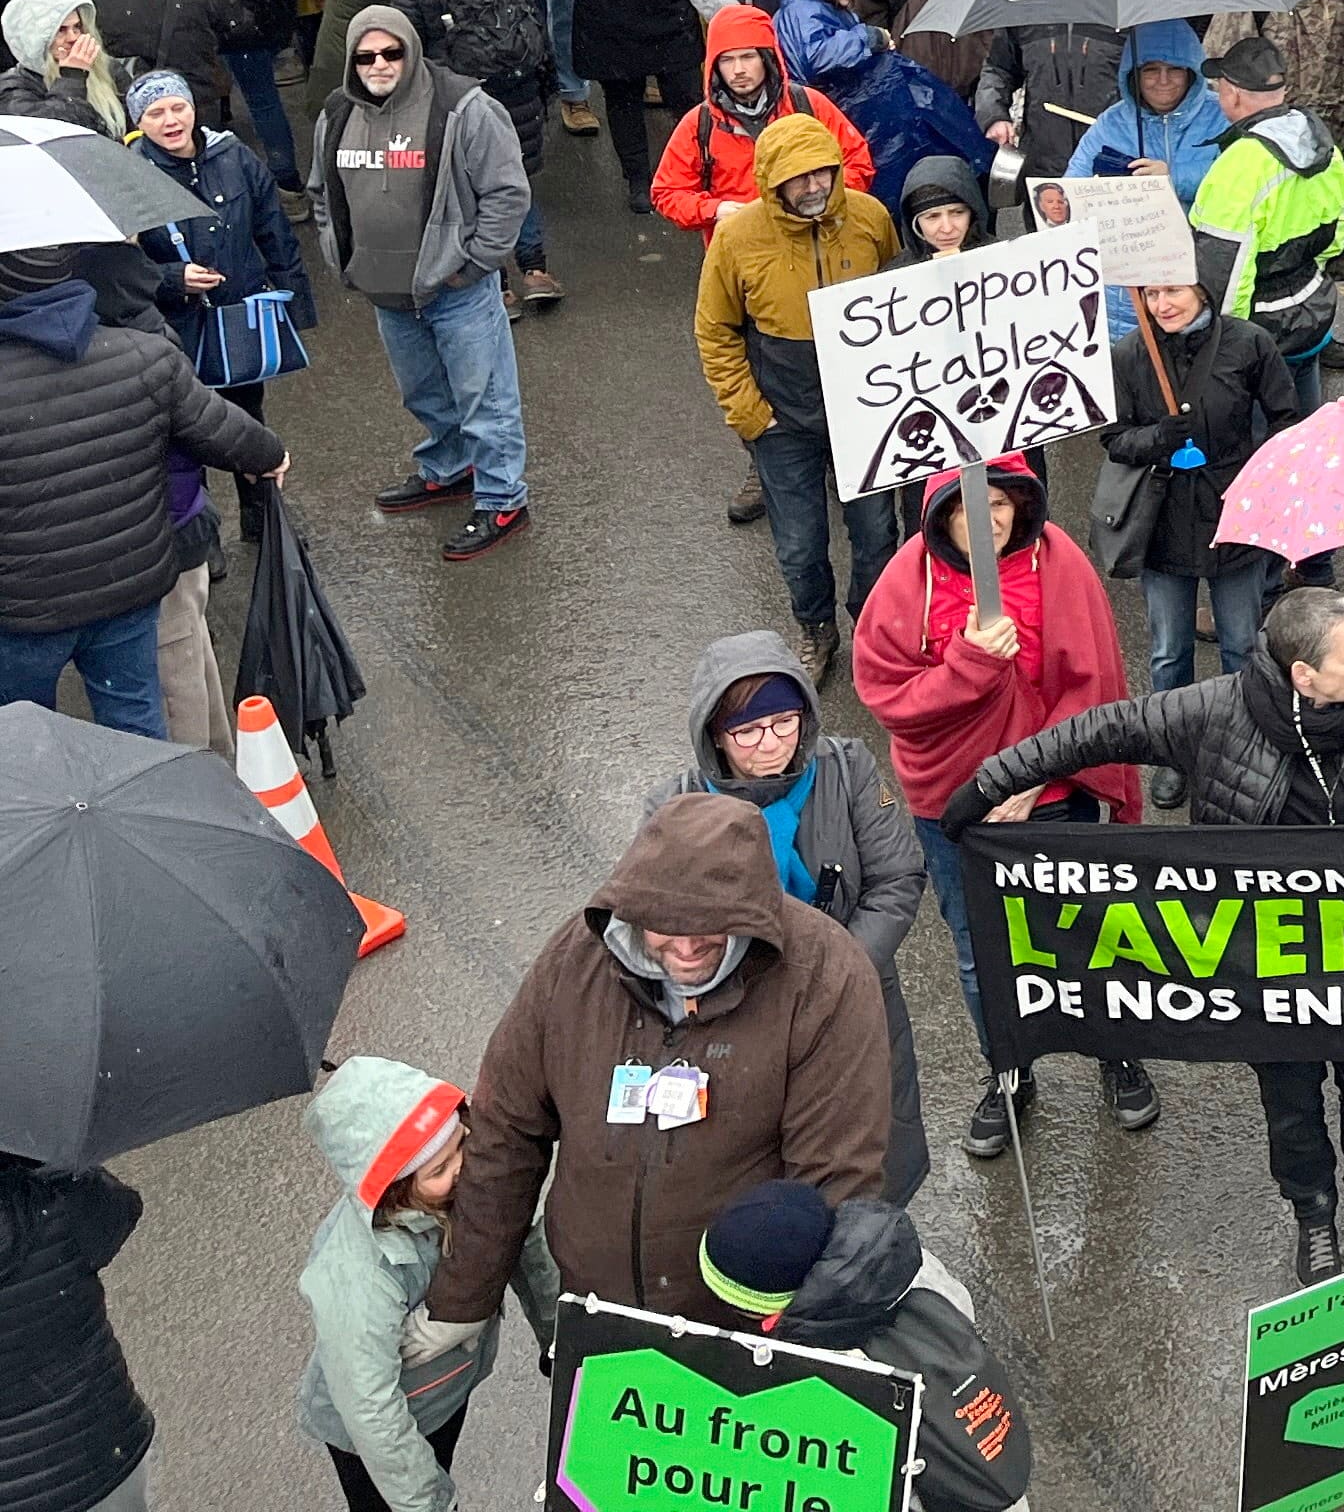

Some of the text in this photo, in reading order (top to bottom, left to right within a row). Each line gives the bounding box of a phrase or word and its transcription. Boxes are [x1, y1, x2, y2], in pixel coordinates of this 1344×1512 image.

[839, 247, 1099, 347] Stoppons
[995, 852, 1139, 895] MÈRES
[1155, 867, 1217, 892] AU
[1015, 974, 1085, 1019] DE
[1107, 980, 1243, 1022] NOS
[706, 1043, 732, 1059] HH
[1255, 1305, 1320, 1341] Pour
[610, 1387, 858, 1476] Au front
[627, 1454, 762, 1510] pour
